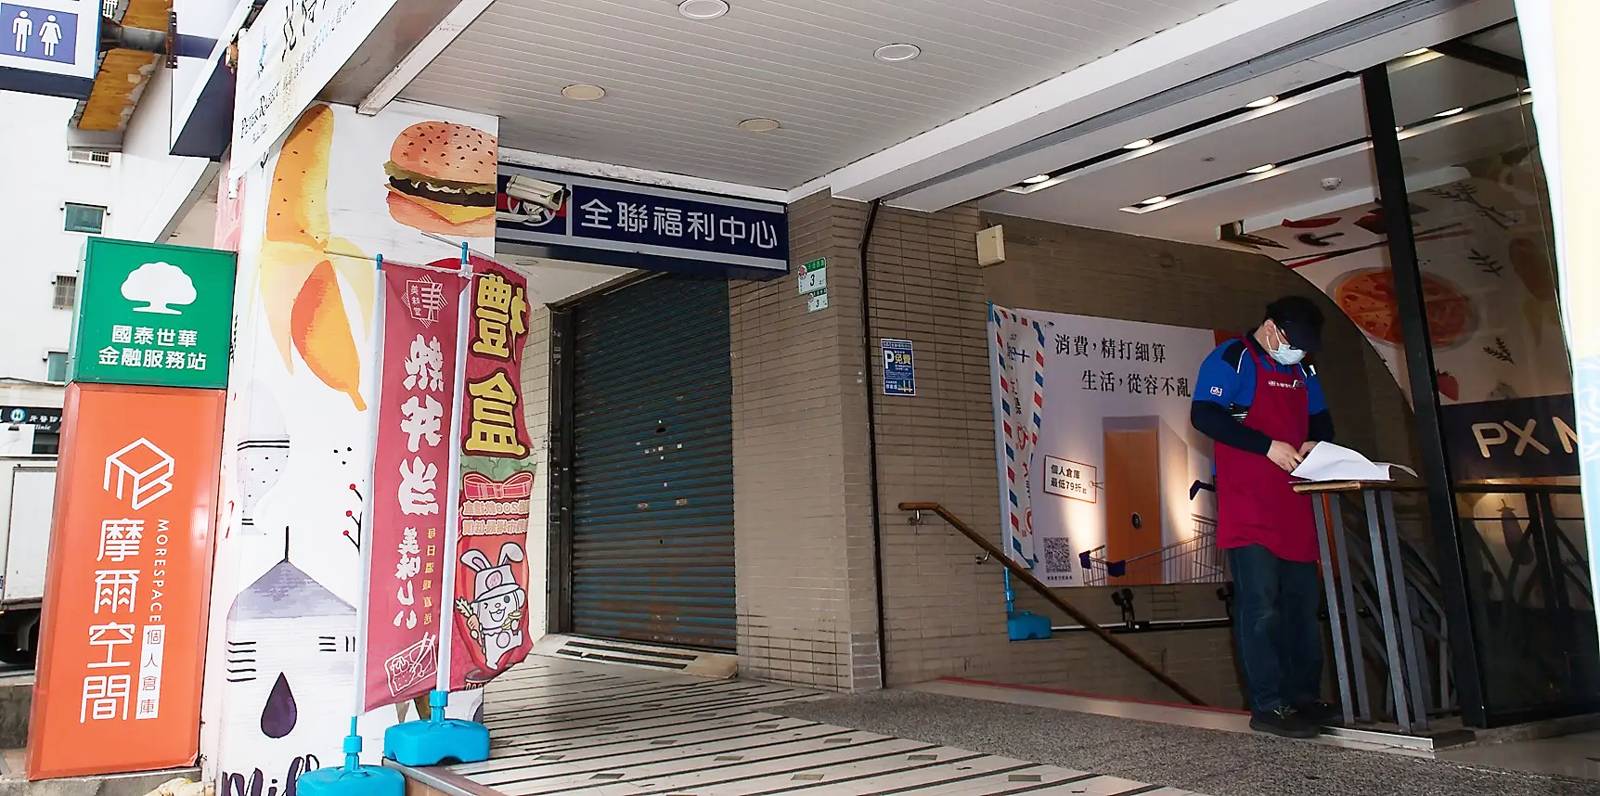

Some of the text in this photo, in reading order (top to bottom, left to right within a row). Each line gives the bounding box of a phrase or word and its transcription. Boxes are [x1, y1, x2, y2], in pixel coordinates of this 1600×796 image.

[580, 198, 778, 250] 全聯福利中心
[810, 274, 815, 286] 3
[112, 324, 198, 347] 國泰世華
[98, 345, 207, 371] 金融服務站
[884, 350, 895, 369] P
[1472, 419, 1550, 458] PX
[149, 518, 170, 623] MORESPACE
[80, 518, 145, 723] 摩爾空間
[139, 628, 162, 715] 個人倉庫
